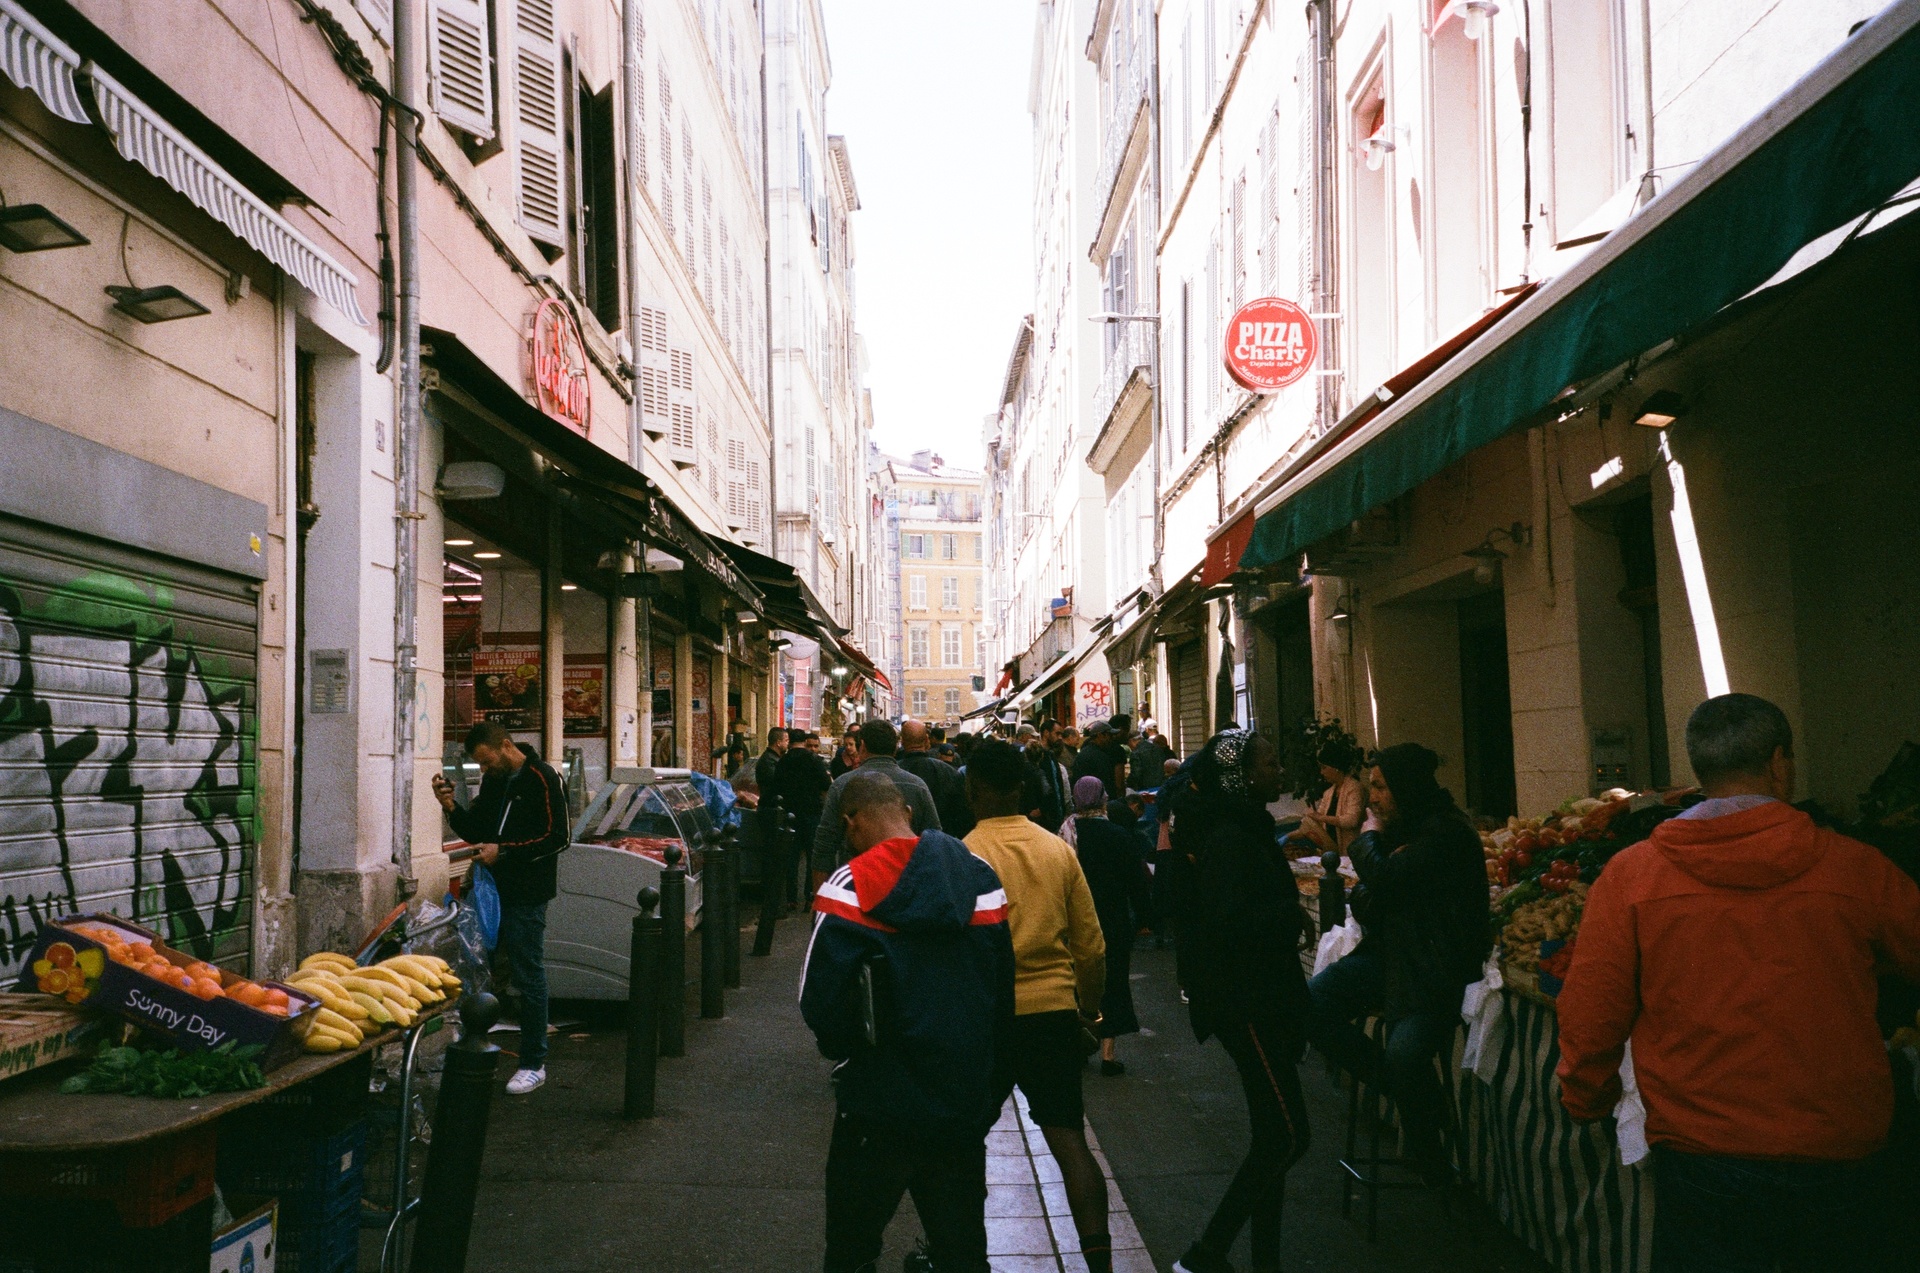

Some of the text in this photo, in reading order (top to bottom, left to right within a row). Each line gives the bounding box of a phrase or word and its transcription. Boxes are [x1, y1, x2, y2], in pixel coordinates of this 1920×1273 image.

[1239, 322, 1304, 346] PIZZA
[1234, 343, 1308, 364] Charly
[125, 988, 186, 1029] Sunny
[186, 1014, 226, 1046] Day
